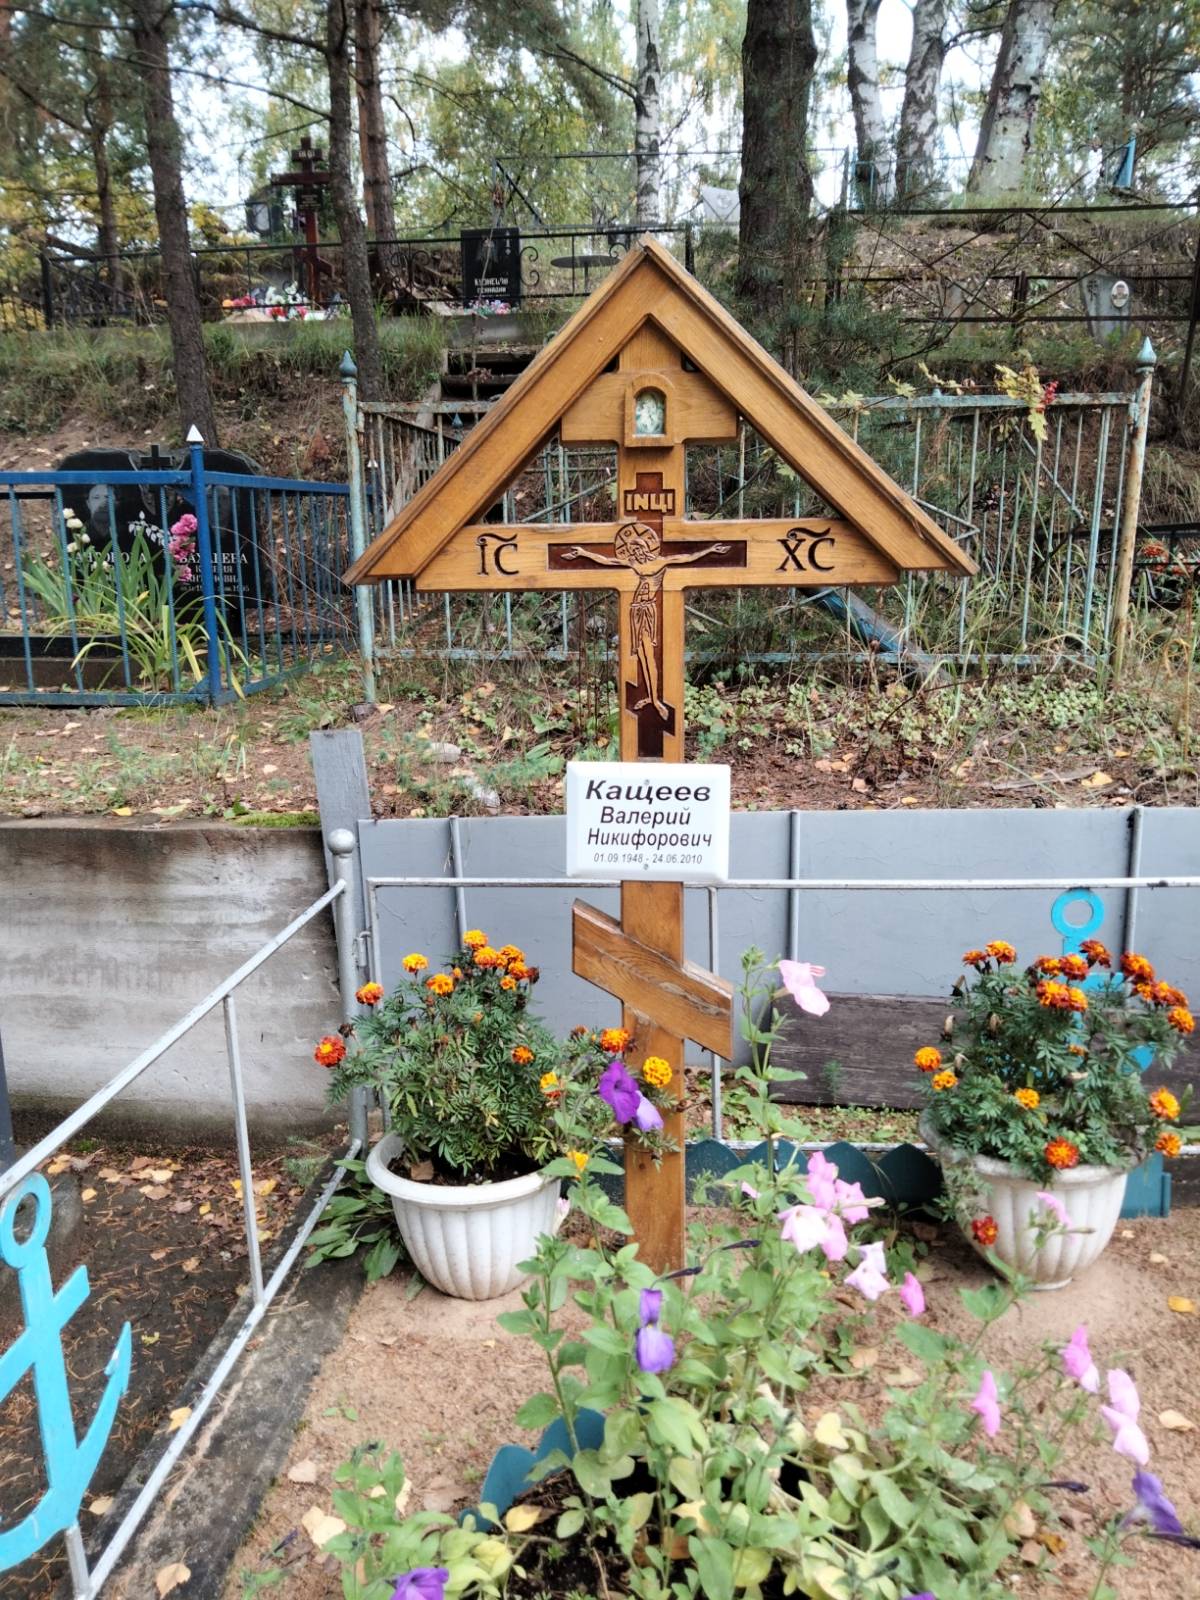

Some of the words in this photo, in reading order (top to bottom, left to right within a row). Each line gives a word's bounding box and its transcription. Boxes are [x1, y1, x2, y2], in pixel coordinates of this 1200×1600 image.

[585, 780, 711, 804] Кащеев
[600, 806, 691, 828] Валерий
[587, 828, 712, 850] Никифорович
[593, 853, 643, 863] 01.09.1948
[652, 853, 703, 864] 24.06.2010
